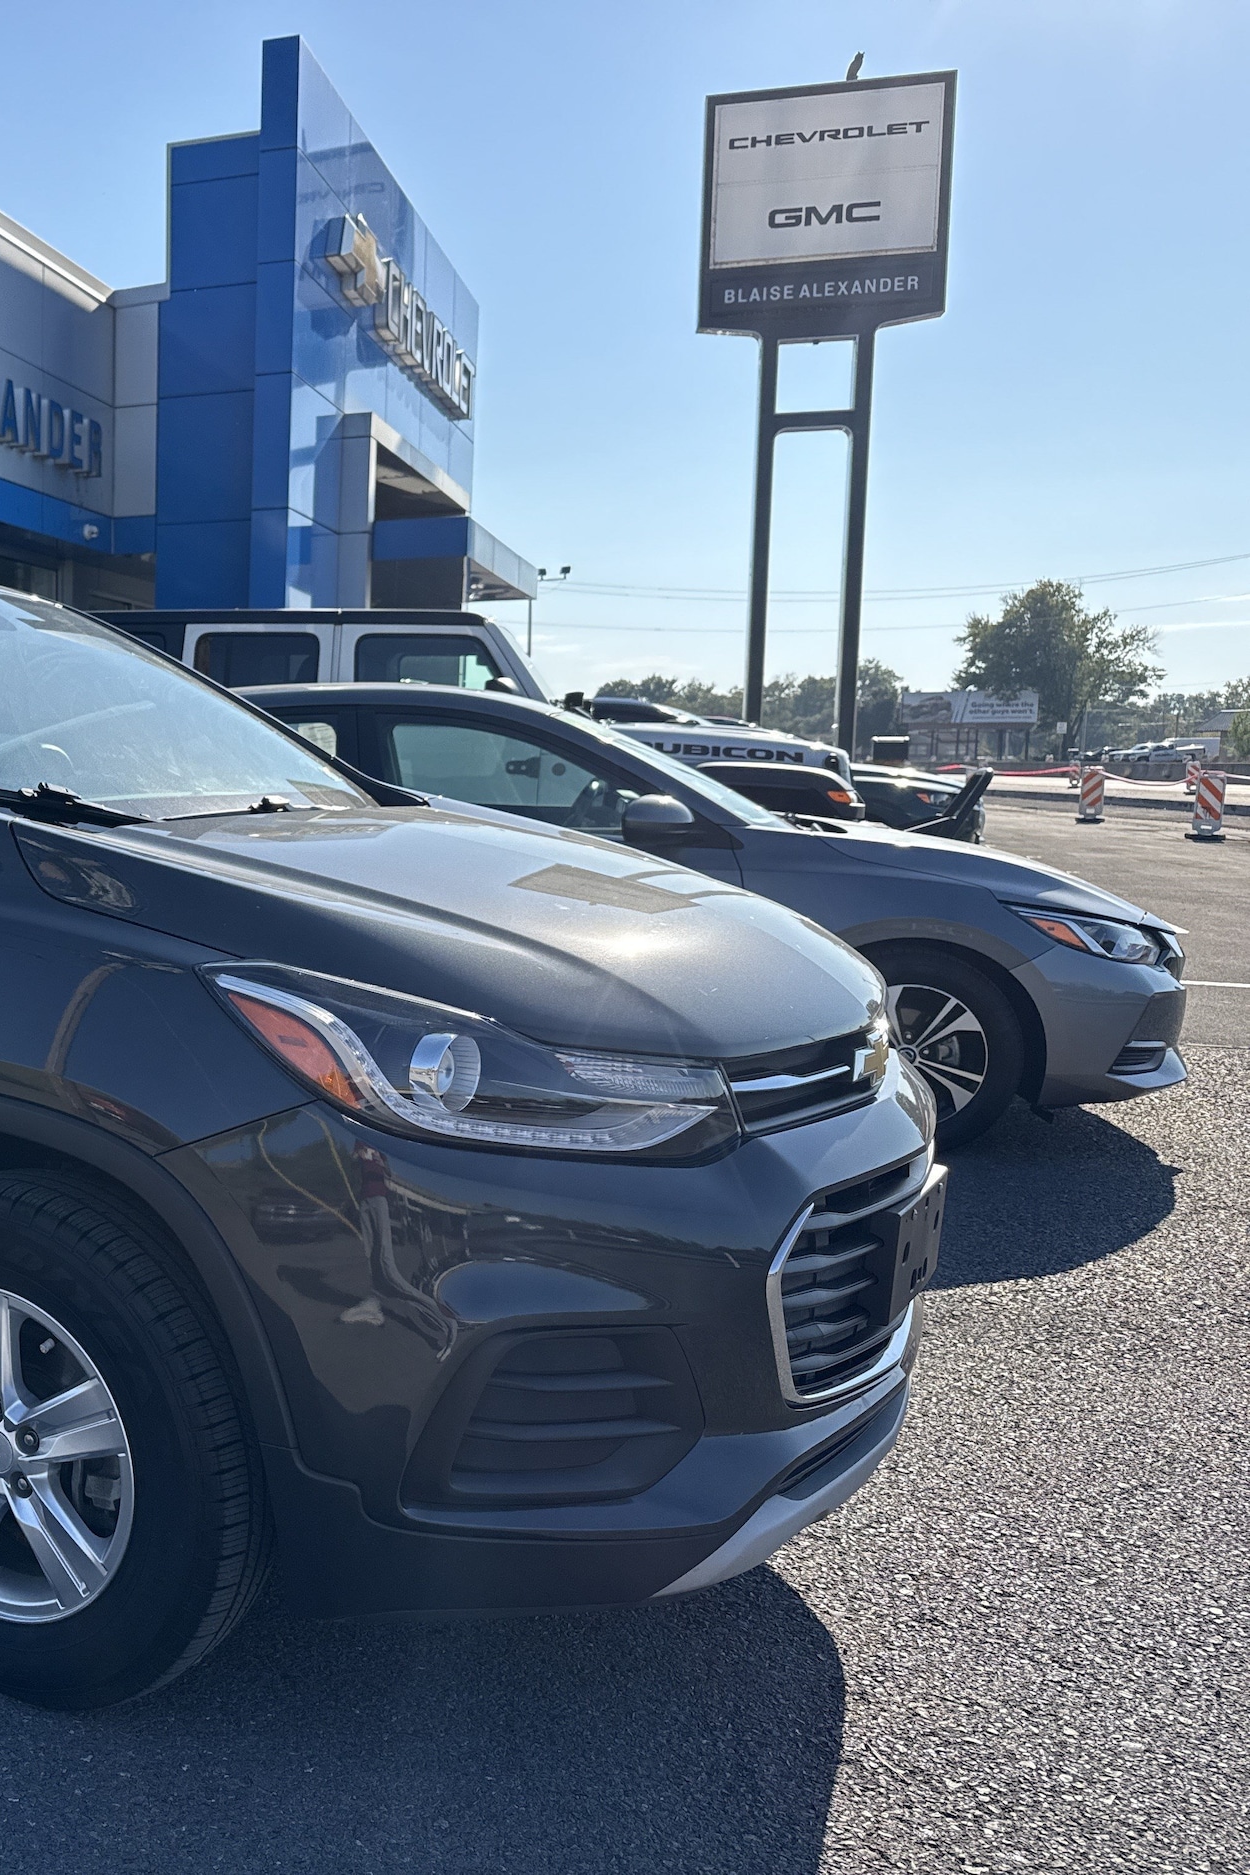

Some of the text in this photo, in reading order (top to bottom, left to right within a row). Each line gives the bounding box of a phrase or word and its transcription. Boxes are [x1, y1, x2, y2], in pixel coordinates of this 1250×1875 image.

[728, 120, 930, 150] CHEVROLET
[768, 200, 881, 229] GMC
[724, 275, 919, 304] BLAISE ALEXANDER
[640, 741, 804, 763] UBICON
